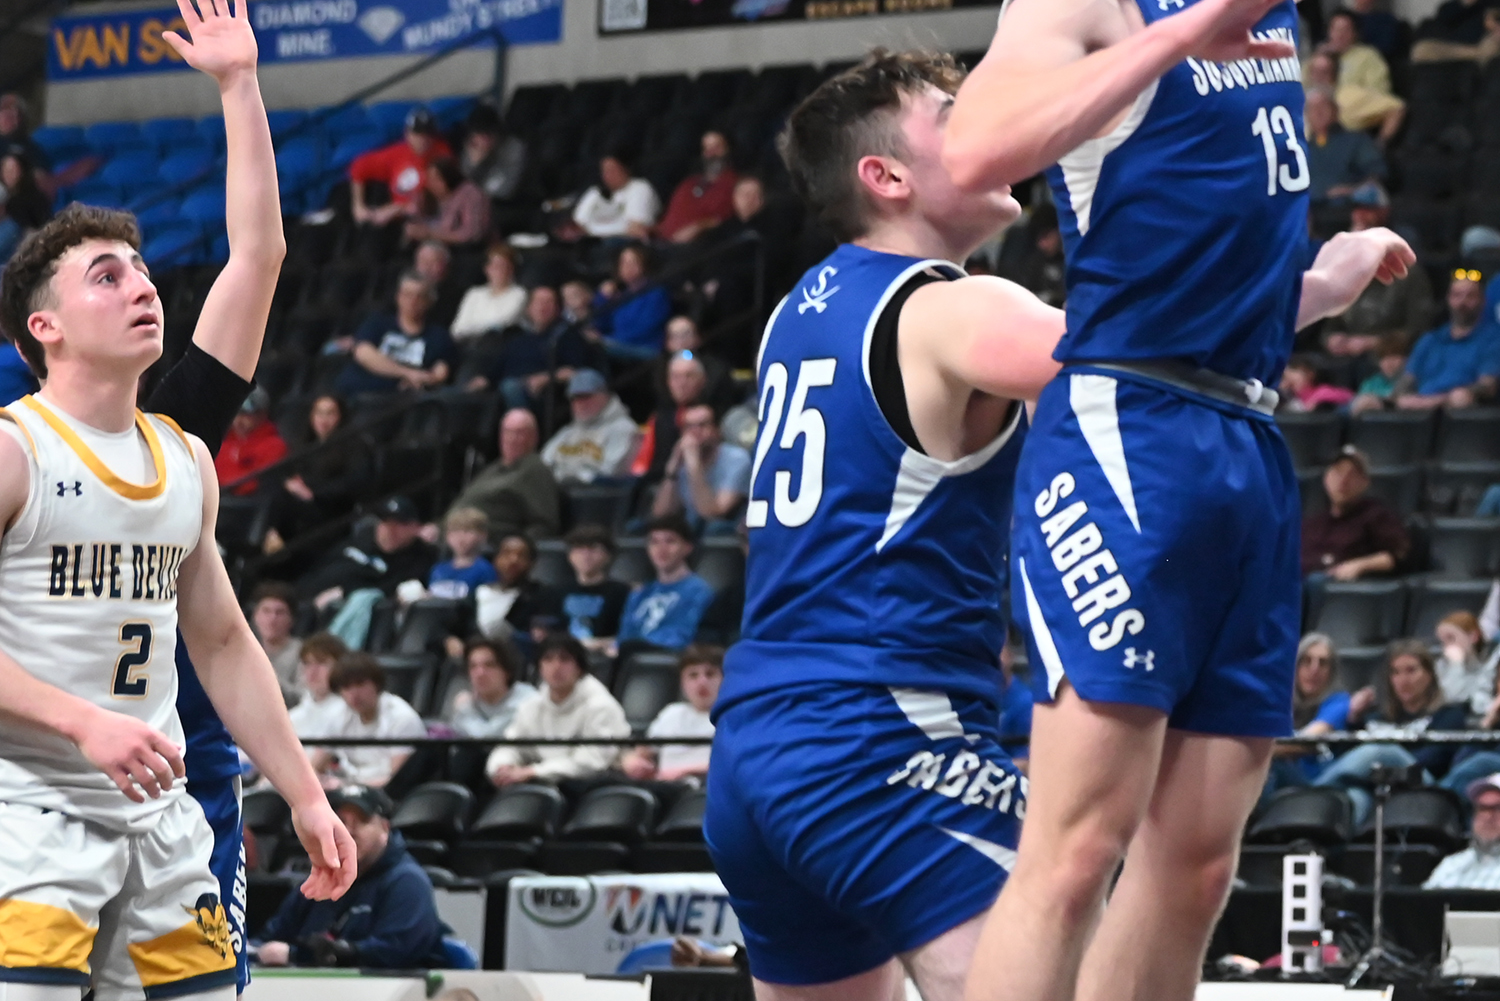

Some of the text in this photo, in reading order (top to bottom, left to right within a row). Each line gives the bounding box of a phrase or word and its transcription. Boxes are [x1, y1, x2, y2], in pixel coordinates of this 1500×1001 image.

[54, 23, 130, 70] VAN
[1251, 105, 1311, 196] 13
[746, 358, 837, 528] 25
[48, 544, 122, 599] BLUE
[1034, 471, 1146, 652] SABERS
[112, 621, 153, 697] 2
